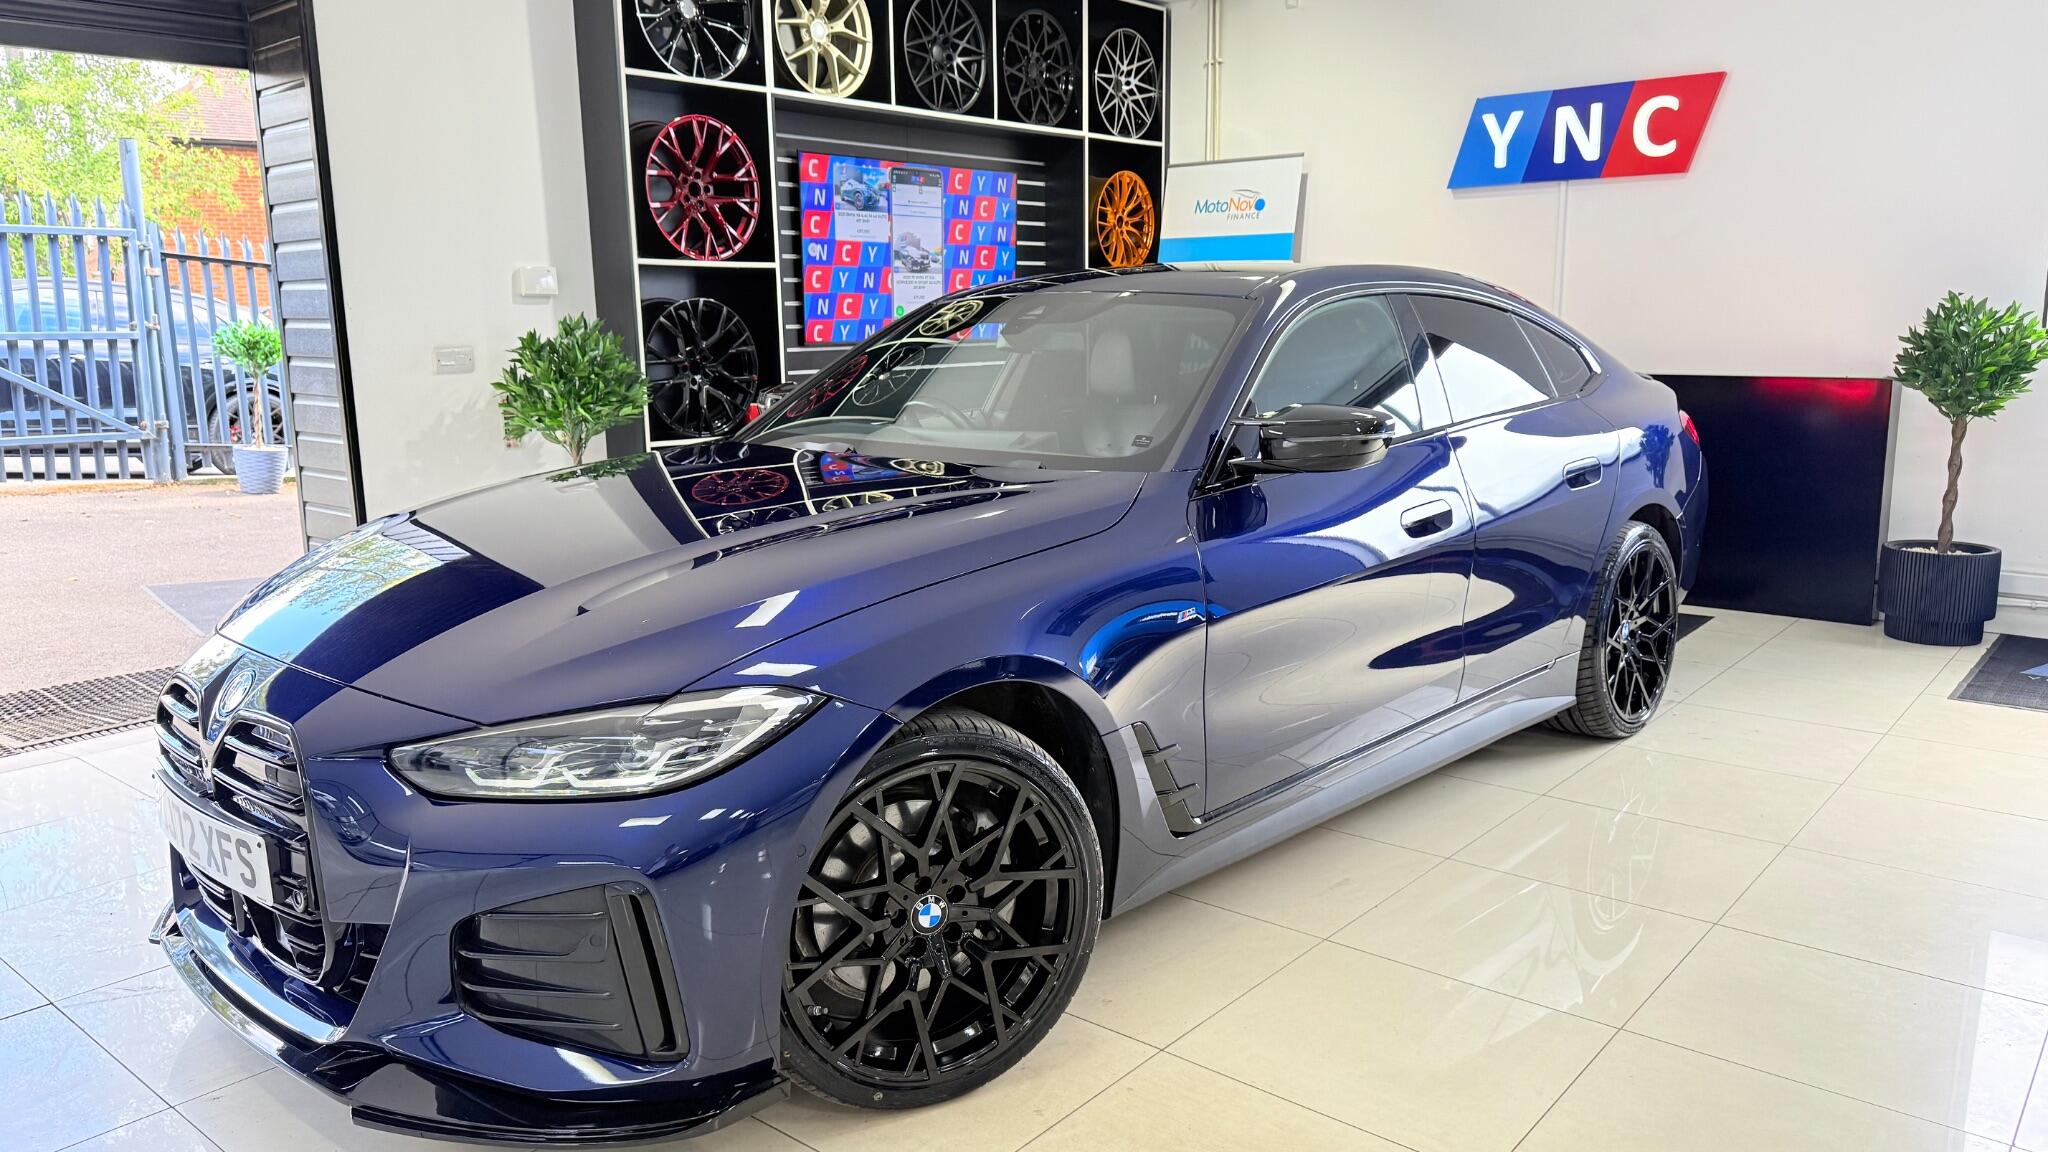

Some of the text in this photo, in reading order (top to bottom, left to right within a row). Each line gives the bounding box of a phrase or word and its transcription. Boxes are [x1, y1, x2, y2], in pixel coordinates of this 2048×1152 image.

[1482, 95, 1680, 168] YNC
[1227, 212, 1260, 221] FINANCE
[200, 822, 257, 889] XFS
[915, 897, 946, 910] BMW
